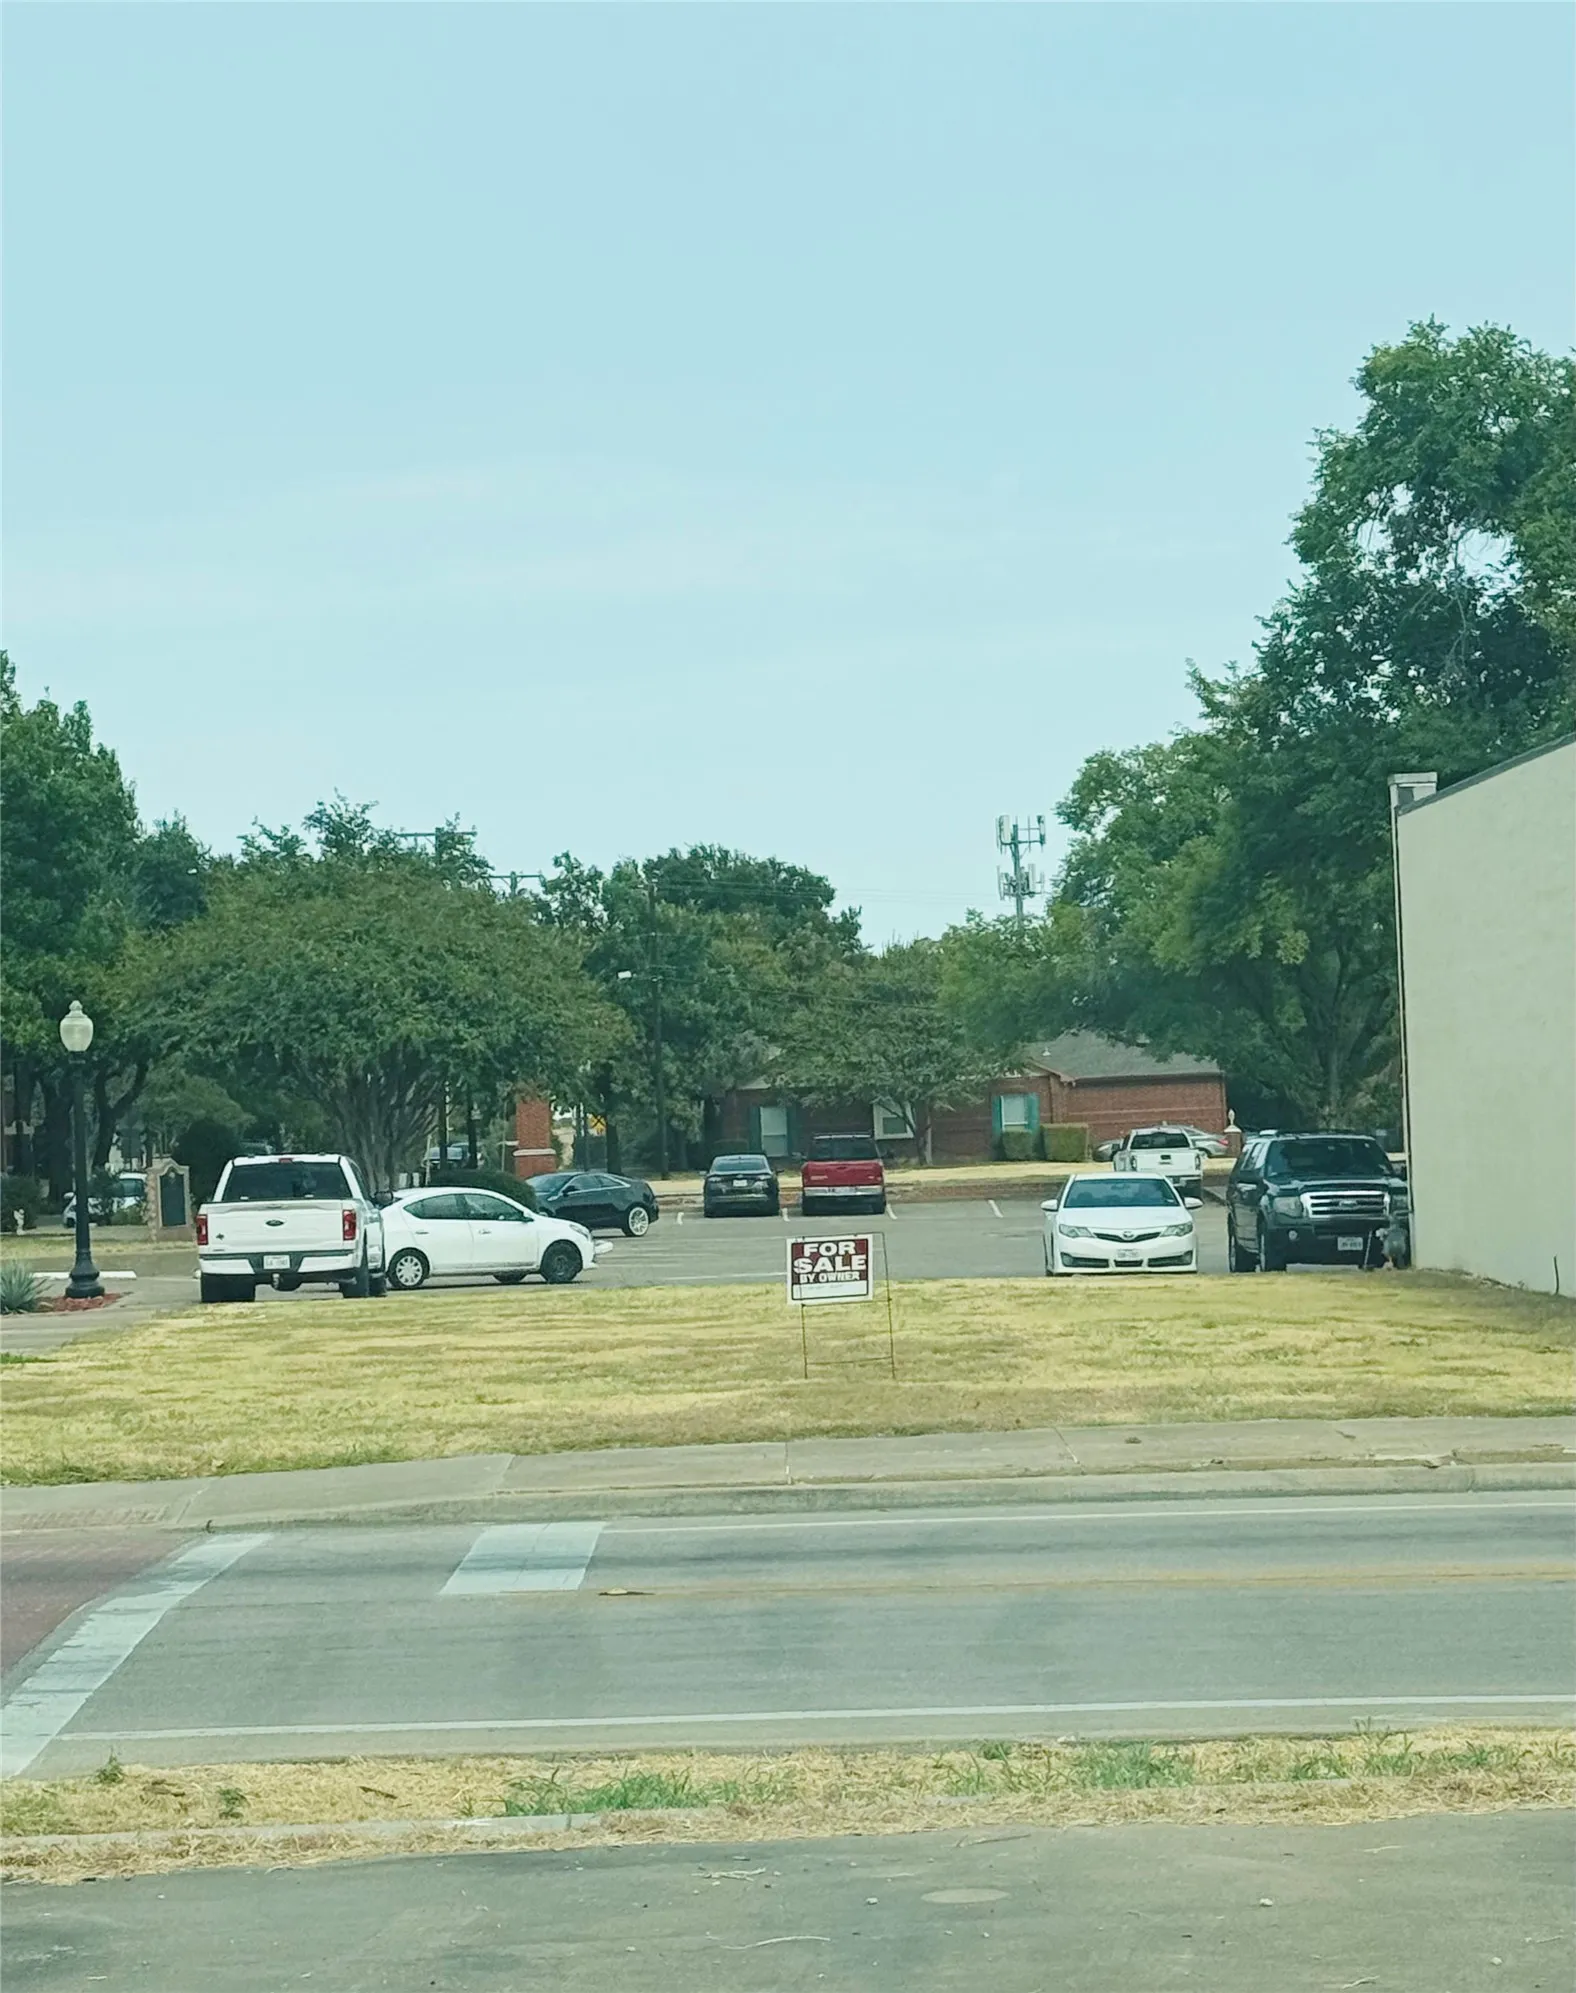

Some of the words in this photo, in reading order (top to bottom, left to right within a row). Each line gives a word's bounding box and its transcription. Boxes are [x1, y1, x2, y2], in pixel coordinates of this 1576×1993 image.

[803, 1241, 856, 1257] FOR
[793, 1254, 867, 1274] SALE
[800, 1273, 816, 1284] BY
[818, 1271, 860, 1283] OWNER
